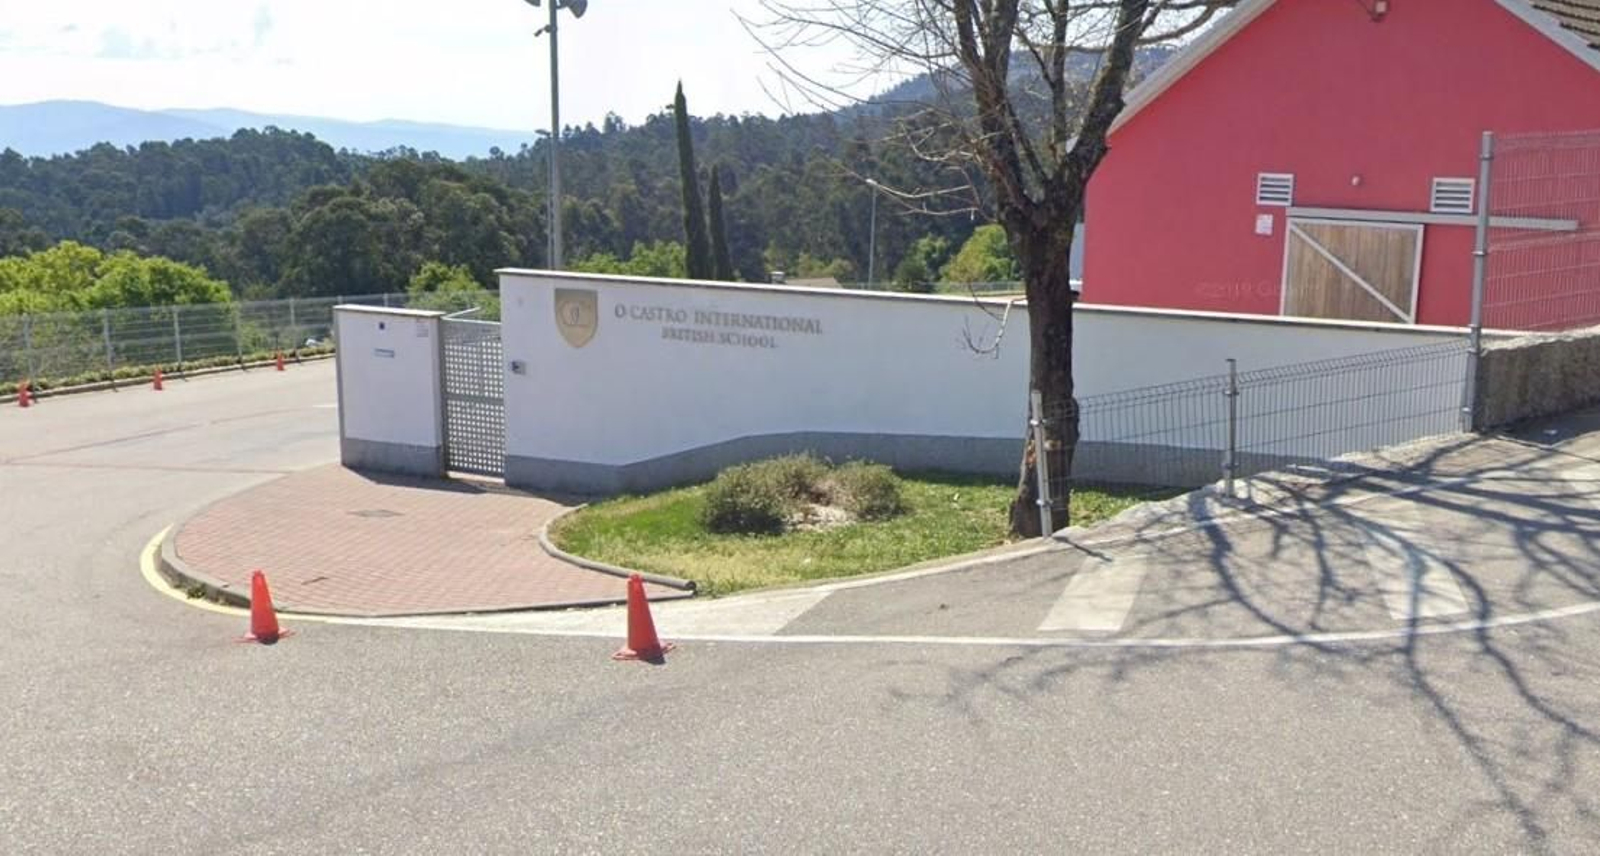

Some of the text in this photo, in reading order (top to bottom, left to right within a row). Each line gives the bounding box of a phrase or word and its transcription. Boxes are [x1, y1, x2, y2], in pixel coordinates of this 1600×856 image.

[614, 304, 823, 335] O CASTRO INTERNATIONAL
[661, 327, 778, 348] BRITISH SCHOOL
